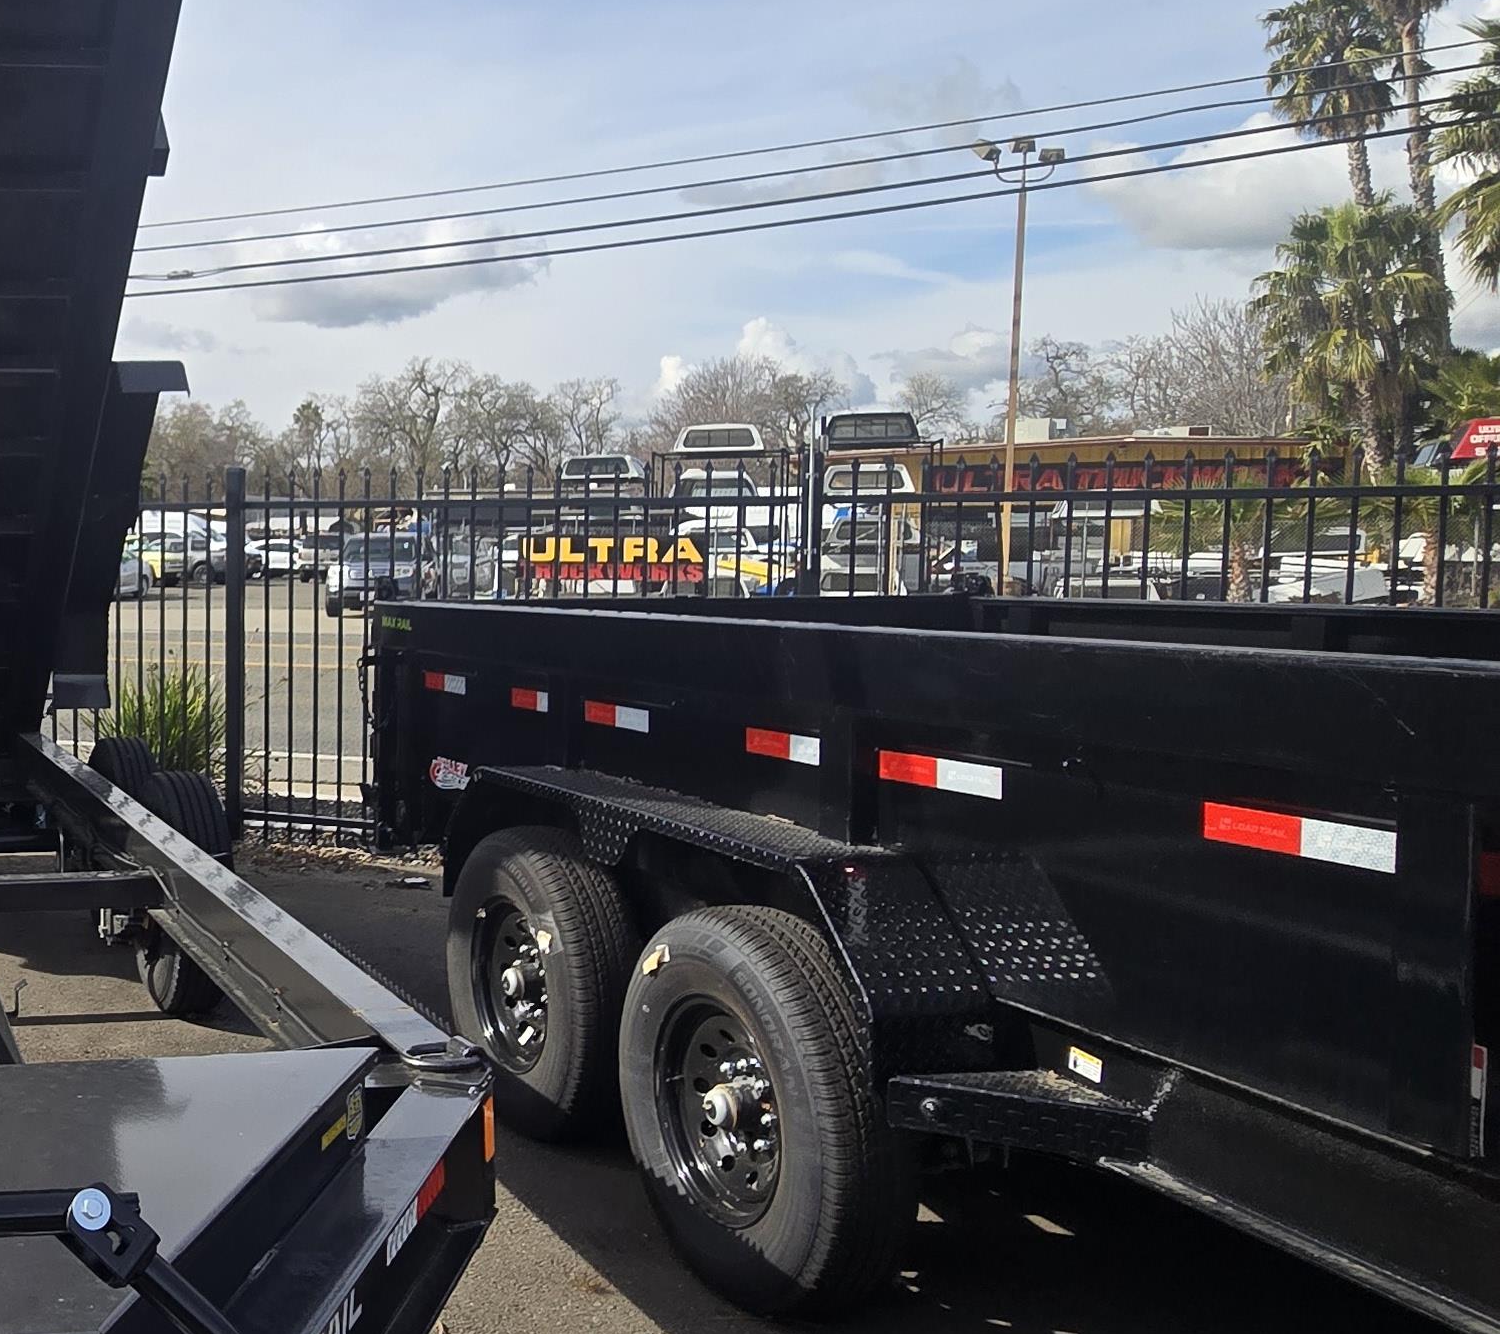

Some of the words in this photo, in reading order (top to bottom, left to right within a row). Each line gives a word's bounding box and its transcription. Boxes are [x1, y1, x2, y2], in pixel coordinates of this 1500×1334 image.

[933, 467, 1064, 493] ULTRA
[1074, 466, 1298, 493] TRUCKW
[522, 537, 704, 563] ULTRA
